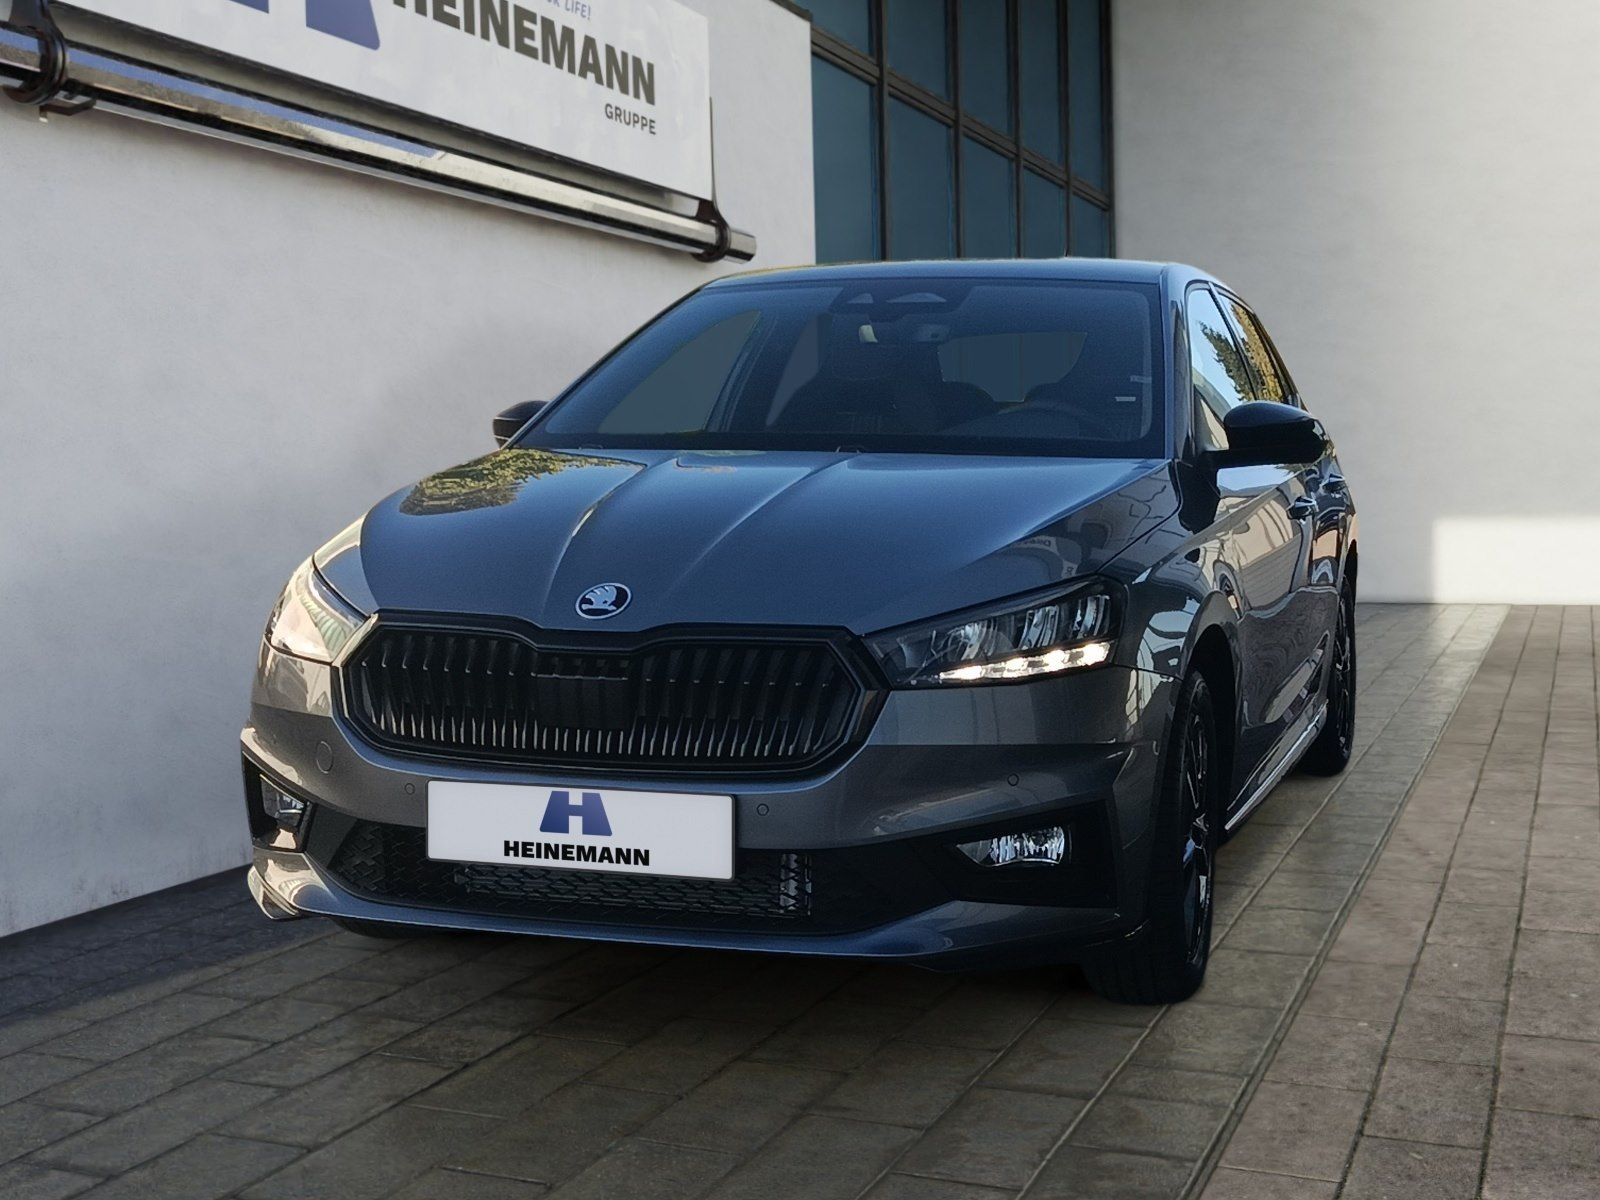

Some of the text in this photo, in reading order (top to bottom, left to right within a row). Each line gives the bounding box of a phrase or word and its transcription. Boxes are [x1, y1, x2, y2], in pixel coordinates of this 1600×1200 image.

[564, 0, 591, 20] LIFE!
[392, 0, 656, 106] EINEMANN
[604, 103, 656, 135] GRUPPE
[503, 840, 650, 867] HEINEMANN
